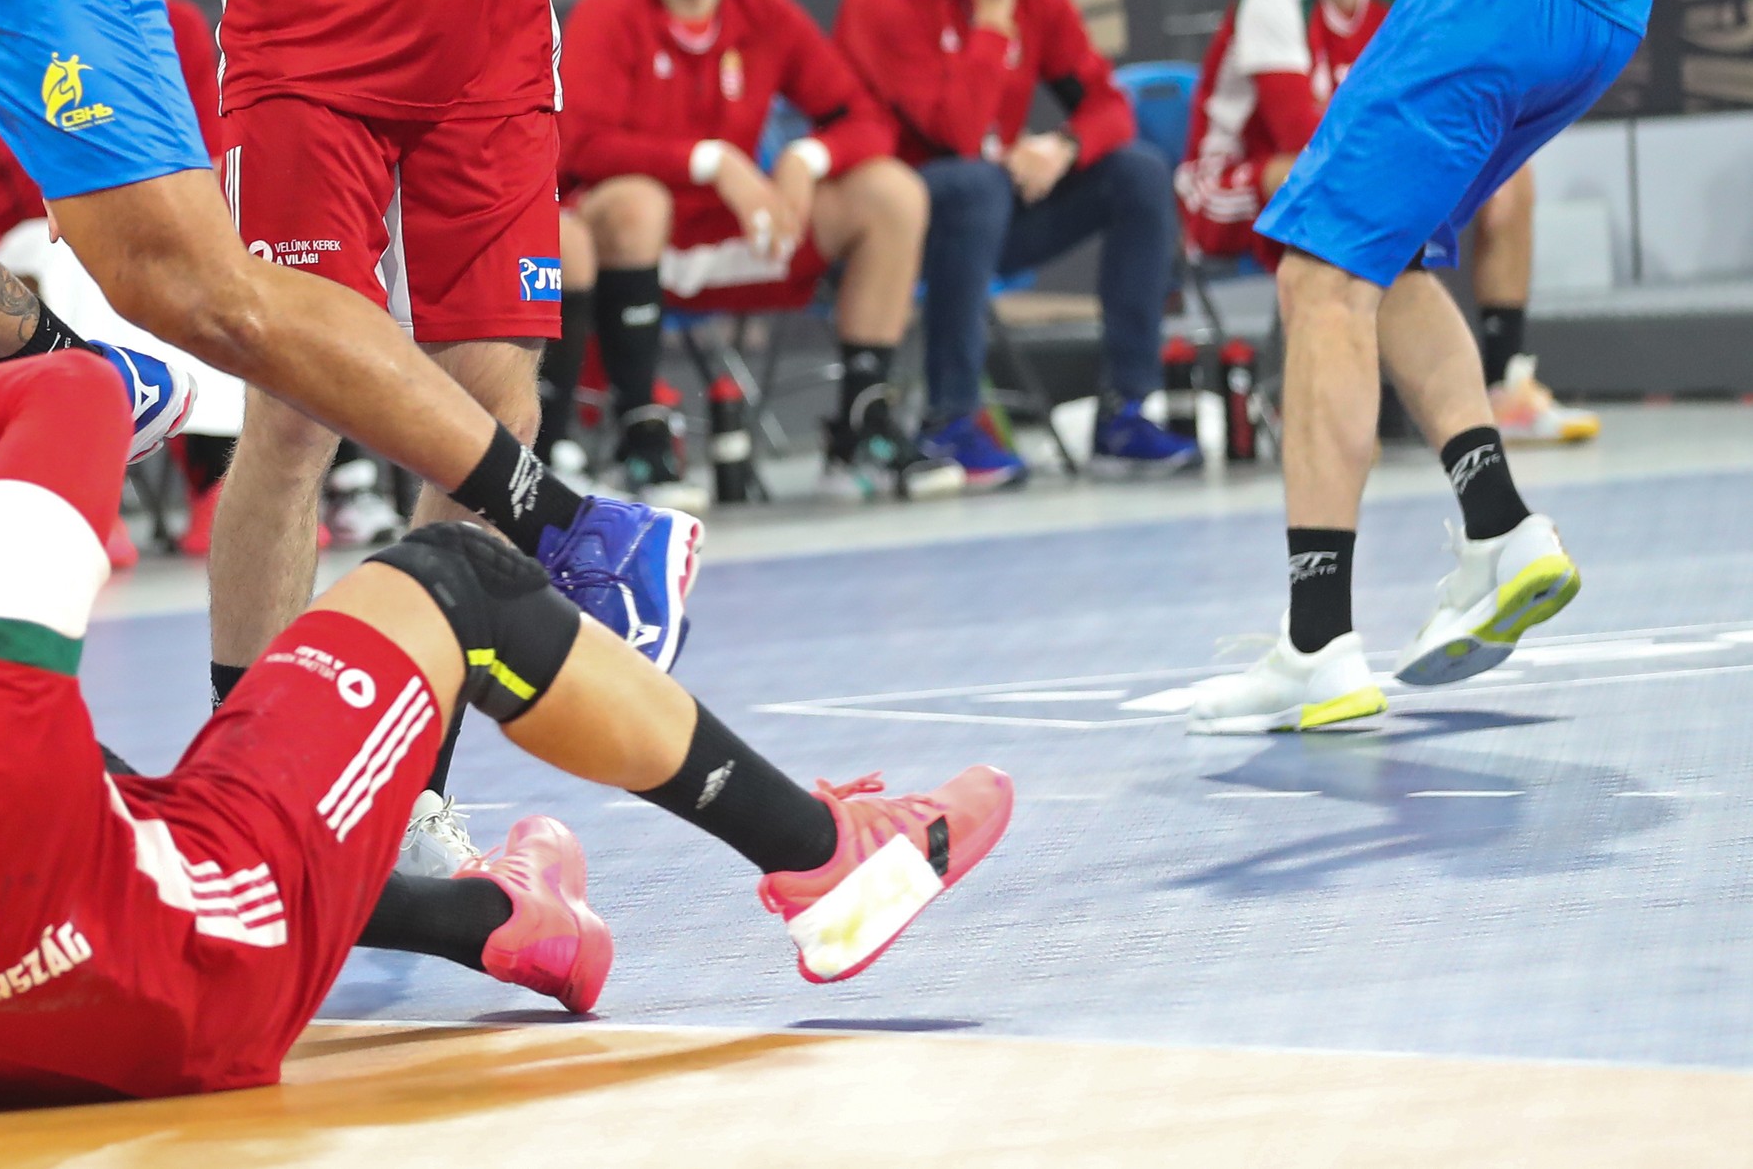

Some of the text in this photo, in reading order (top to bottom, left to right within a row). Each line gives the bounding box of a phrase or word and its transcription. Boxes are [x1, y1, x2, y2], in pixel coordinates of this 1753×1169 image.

[312, 239, 342, 252] KEREK
[276, 252, 319, 266] A VILÁG!
[534, 266, 562, 290] JYS
